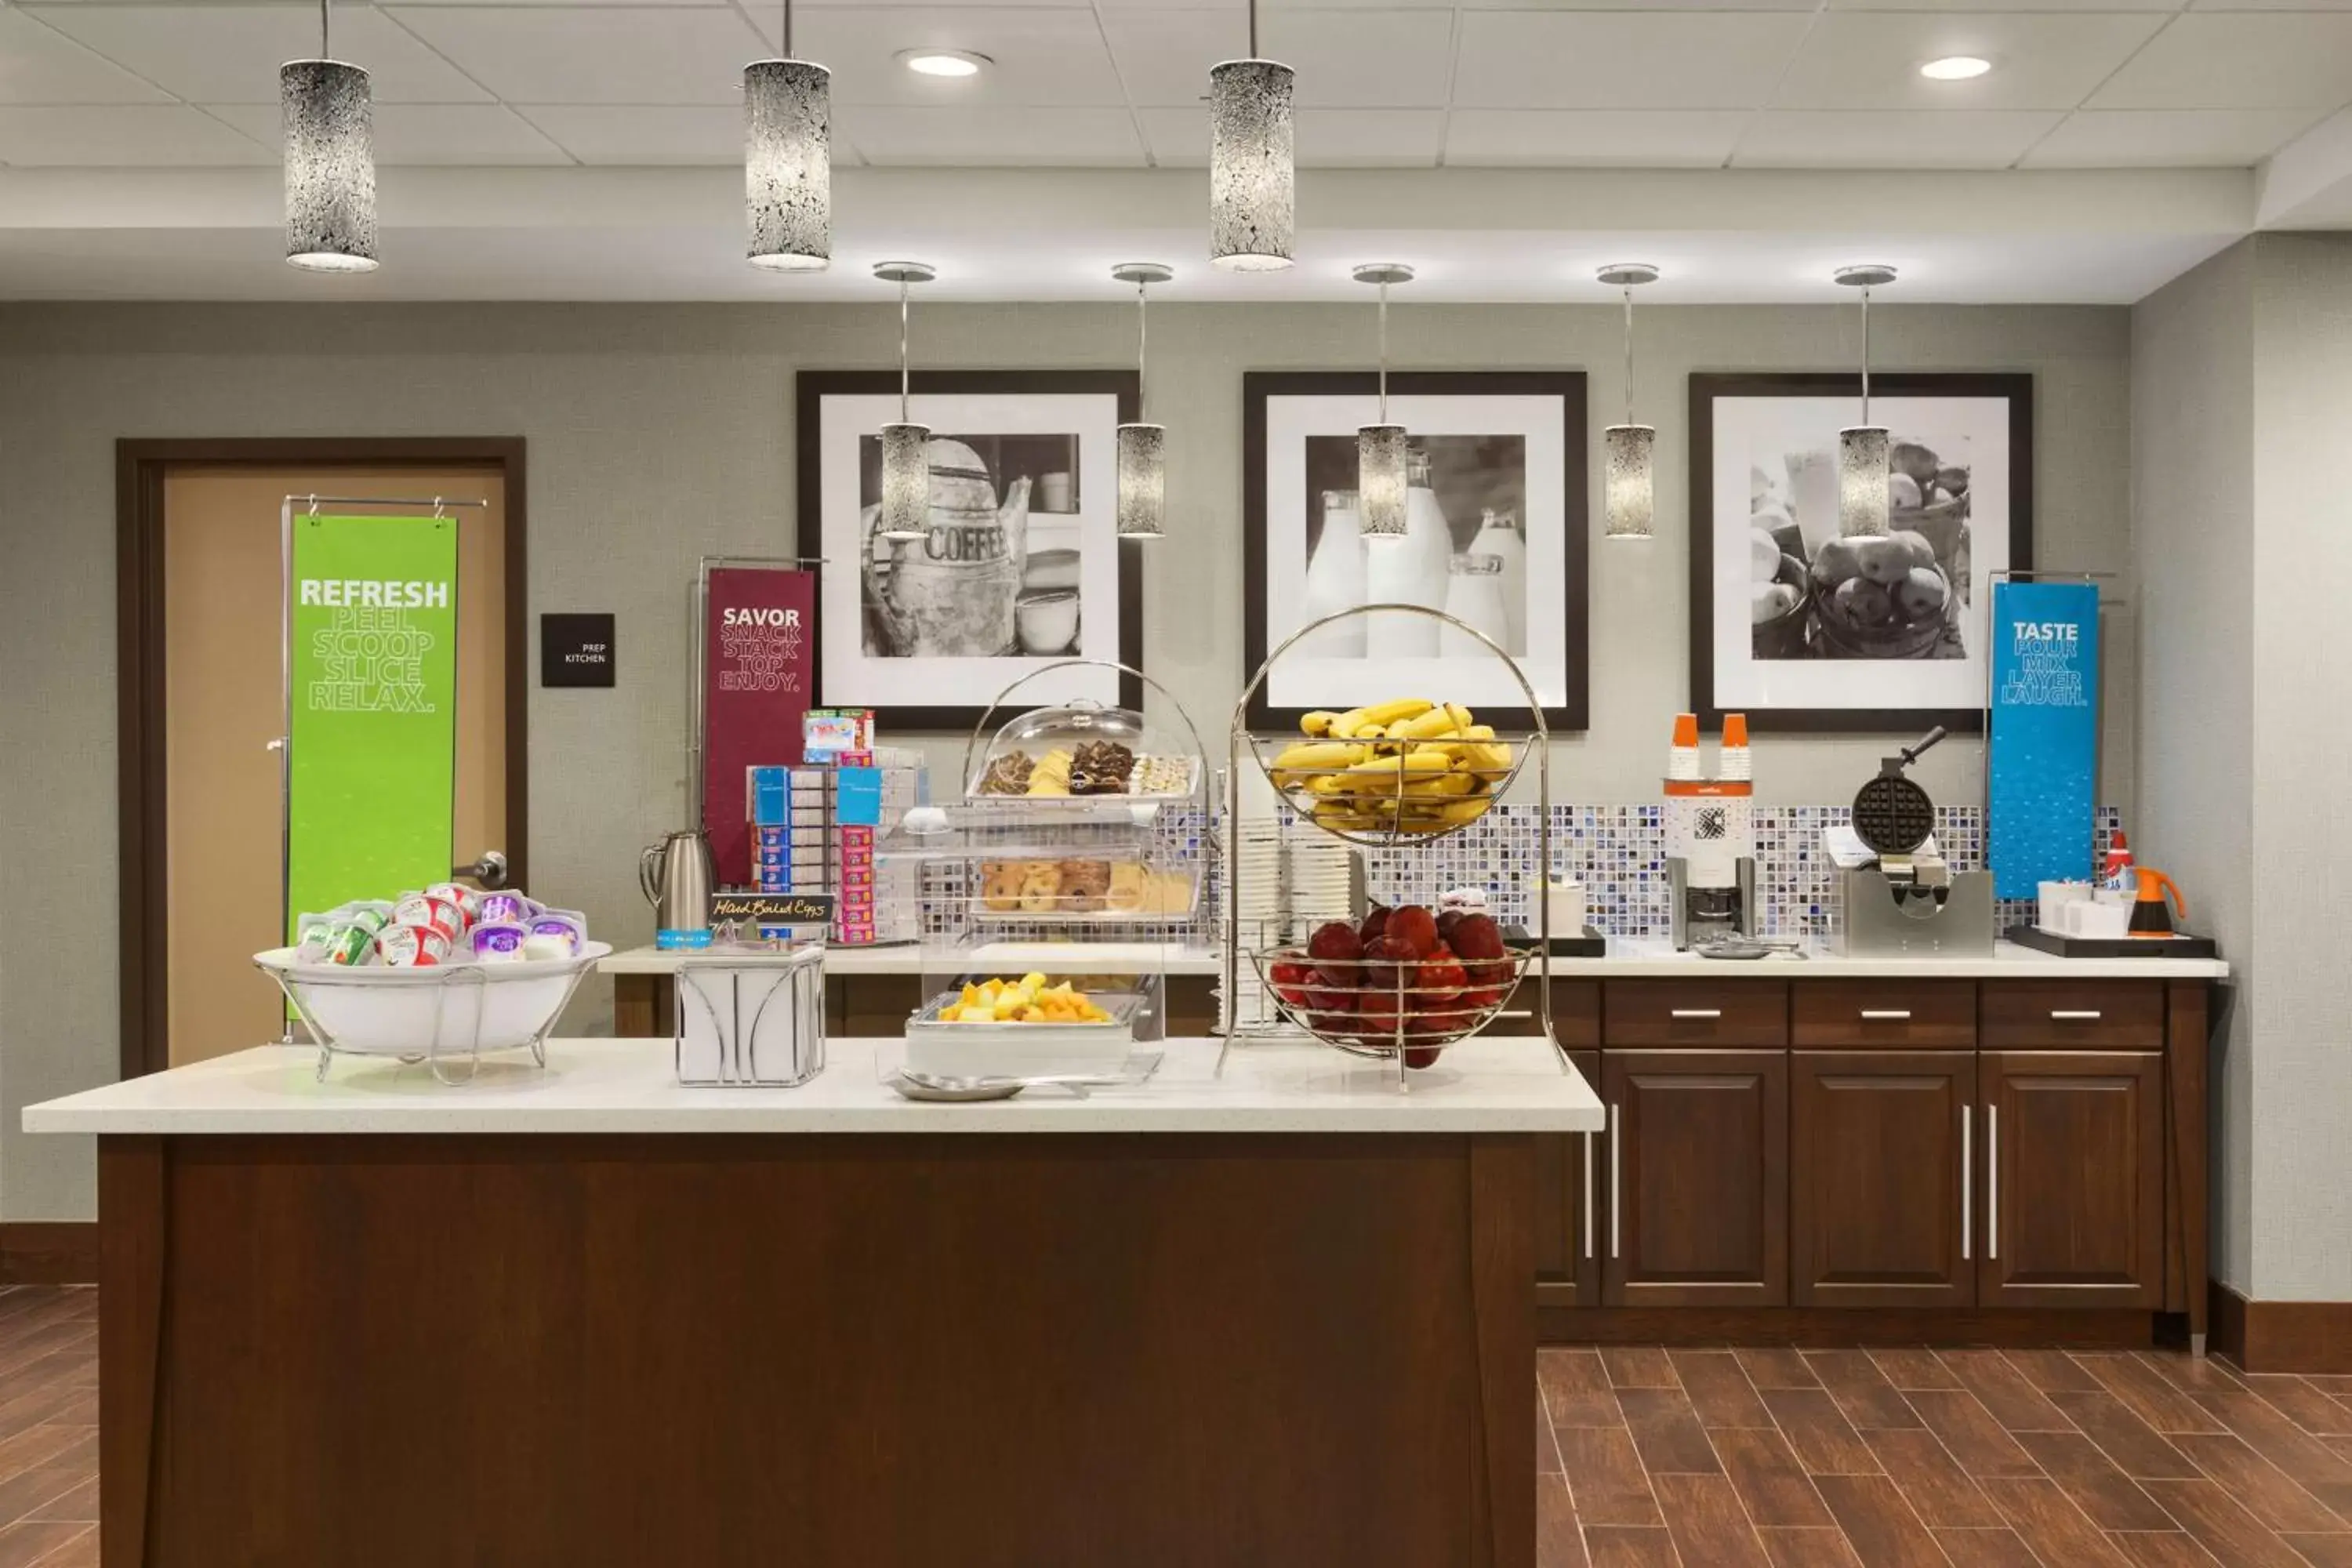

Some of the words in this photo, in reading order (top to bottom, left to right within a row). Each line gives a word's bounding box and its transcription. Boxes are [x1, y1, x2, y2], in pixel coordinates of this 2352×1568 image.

[300, 579, 448, 608] REFRESH
[332, 604, 416, 632] PEEL
[723, 608, 800, 626] SAVOR
[720, 623, 802, 643] SNACK
[2013, 622, 2079, 641] TASTE
[313, 629, 435, 659] SCOOP
[583, 644, 606, 652] PREP
[724, 639, 798, 659] STACK
[2013, 637, 2078, 658] POUR
[565, 654, 606, 663] KITCHEN
[737, 655, 784, 674] TOP
[2022, 653, 2068, 673] MIX
[324, 656, 422, 685] SLICE
[2008, 670, 2082, 691] LAYER
[719, 670, 800, 692] ENJOY.
[308, 681, 436, 713] RELAX.
[2001, 684, 2089, 706] LAUGH.
[794, 899, 826, 919] Eggs
